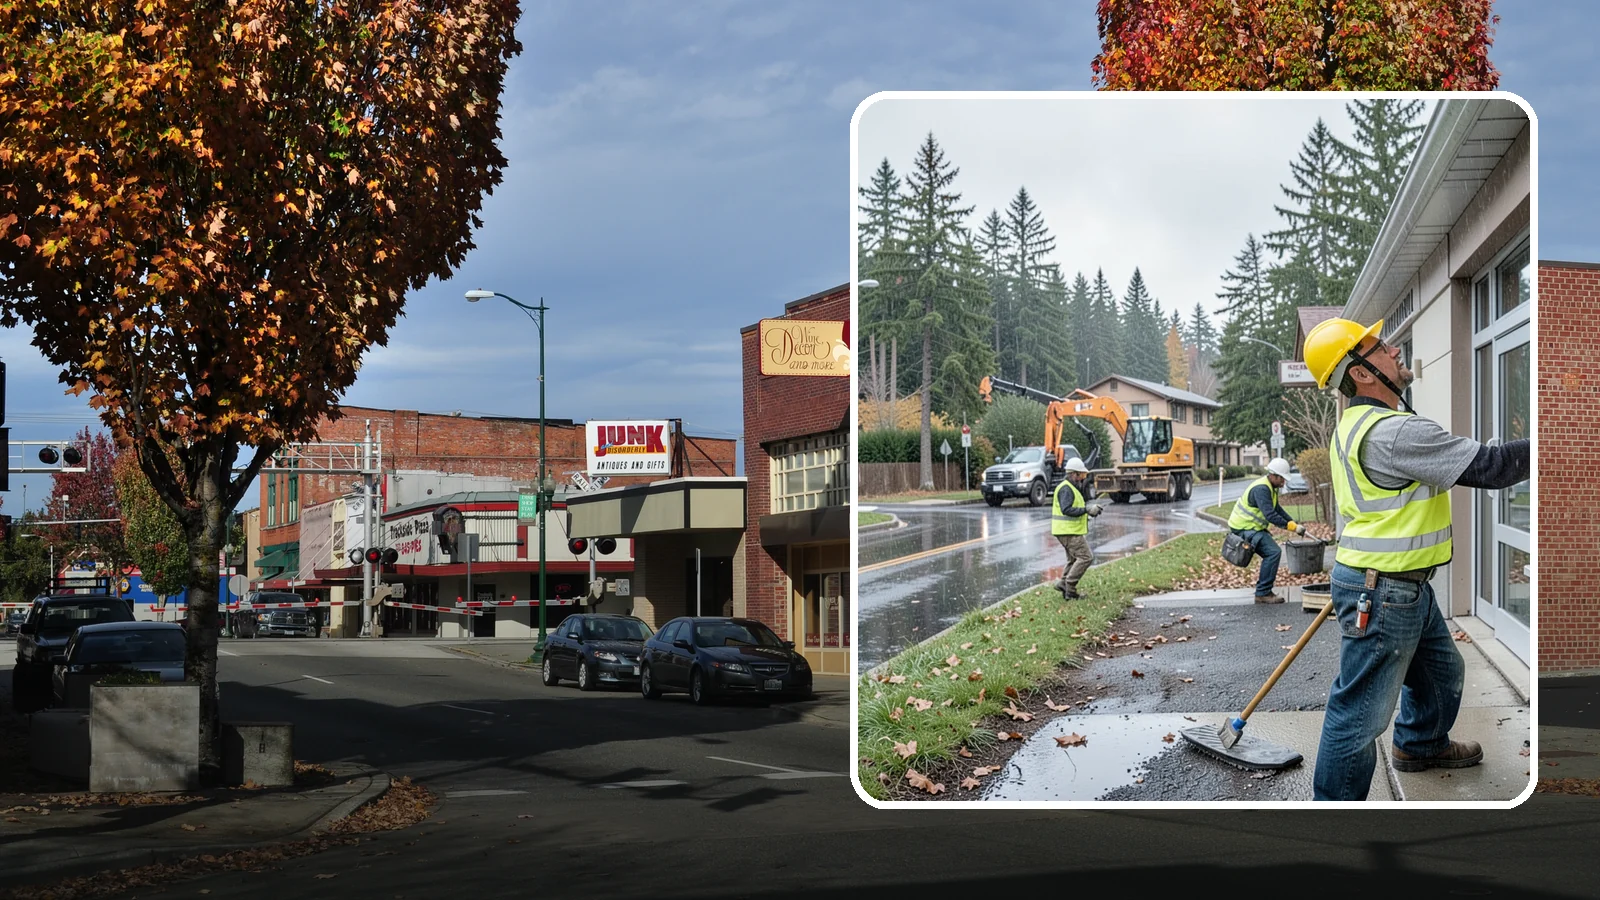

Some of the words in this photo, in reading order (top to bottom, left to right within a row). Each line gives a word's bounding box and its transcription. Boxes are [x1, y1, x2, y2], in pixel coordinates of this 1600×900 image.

[596, 425, 665, 457] JUNK
[608, 446, 646, 454] DISORDERLY
[597, 461, 628, 470] ANTIQUES
[631, 461, 644, 470] AND
[647, 460, 665, 469] GIFTS
[414, 520, 429, 535] Pizza
